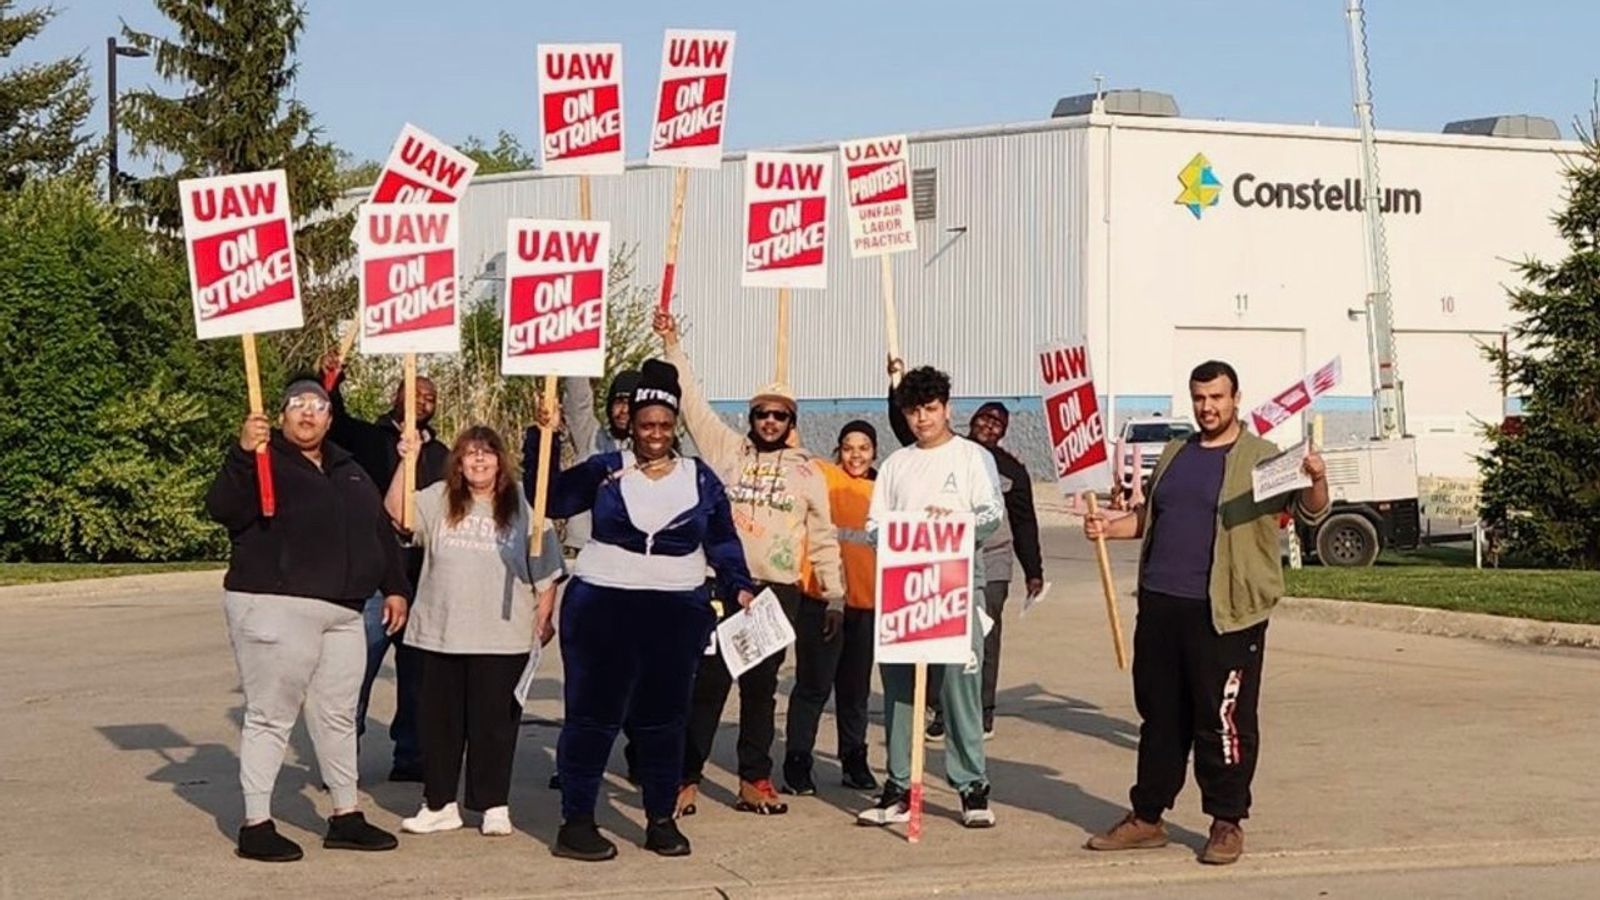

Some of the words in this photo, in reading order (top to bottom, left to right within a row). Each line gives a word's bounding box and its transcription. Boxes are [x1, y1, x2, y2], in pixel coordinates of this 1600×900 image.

[546, 53, 613, 80] UAW
[669, 38, 728, 68] UAW
[563, 89, 595, 124] ON
[676, 78, 705, 112] ON
[545, 109, 620, 159] STRIKE
[653, 100, 725, 149] STRIKE
[400, 135, 466, 189] UAW
[845, 140, 902, 162] UAW
[755, 162, 823, 191] UAW
[1232, 172, 1422, 215] Constellum
[191, 181, 277, 223] UAW
[769, 200, 802, 234] ON
[858, 204, 902, 221] UNFAIR
[369, 213, 449, 245] UAW
[747, 221, 825, 271] STRIKE
[854, 231, 912, 250] PRACTICE
[862, 219, 902, 235] LABOR
[218, 230, 257, 273] ON
[517, 230, 600, 264] UAW
[199, 248, 291, 320] STRIKE
[388, 257, 425, 295] ON
[534, 275, 573, 314] ON
[365, 277, 454, 336] STRIKE
[507, 300, 601, 355] STRIKE
[1040, 346, 1087, 385] UAW
[1058, 391, 1081, 431] ON
[1055, 415, 1103, 472] STRIKE
[888, 522, 966, 552] UAW
[904, 564, 941, 602] ON
[880, 587, 968, 642] STRIKE
